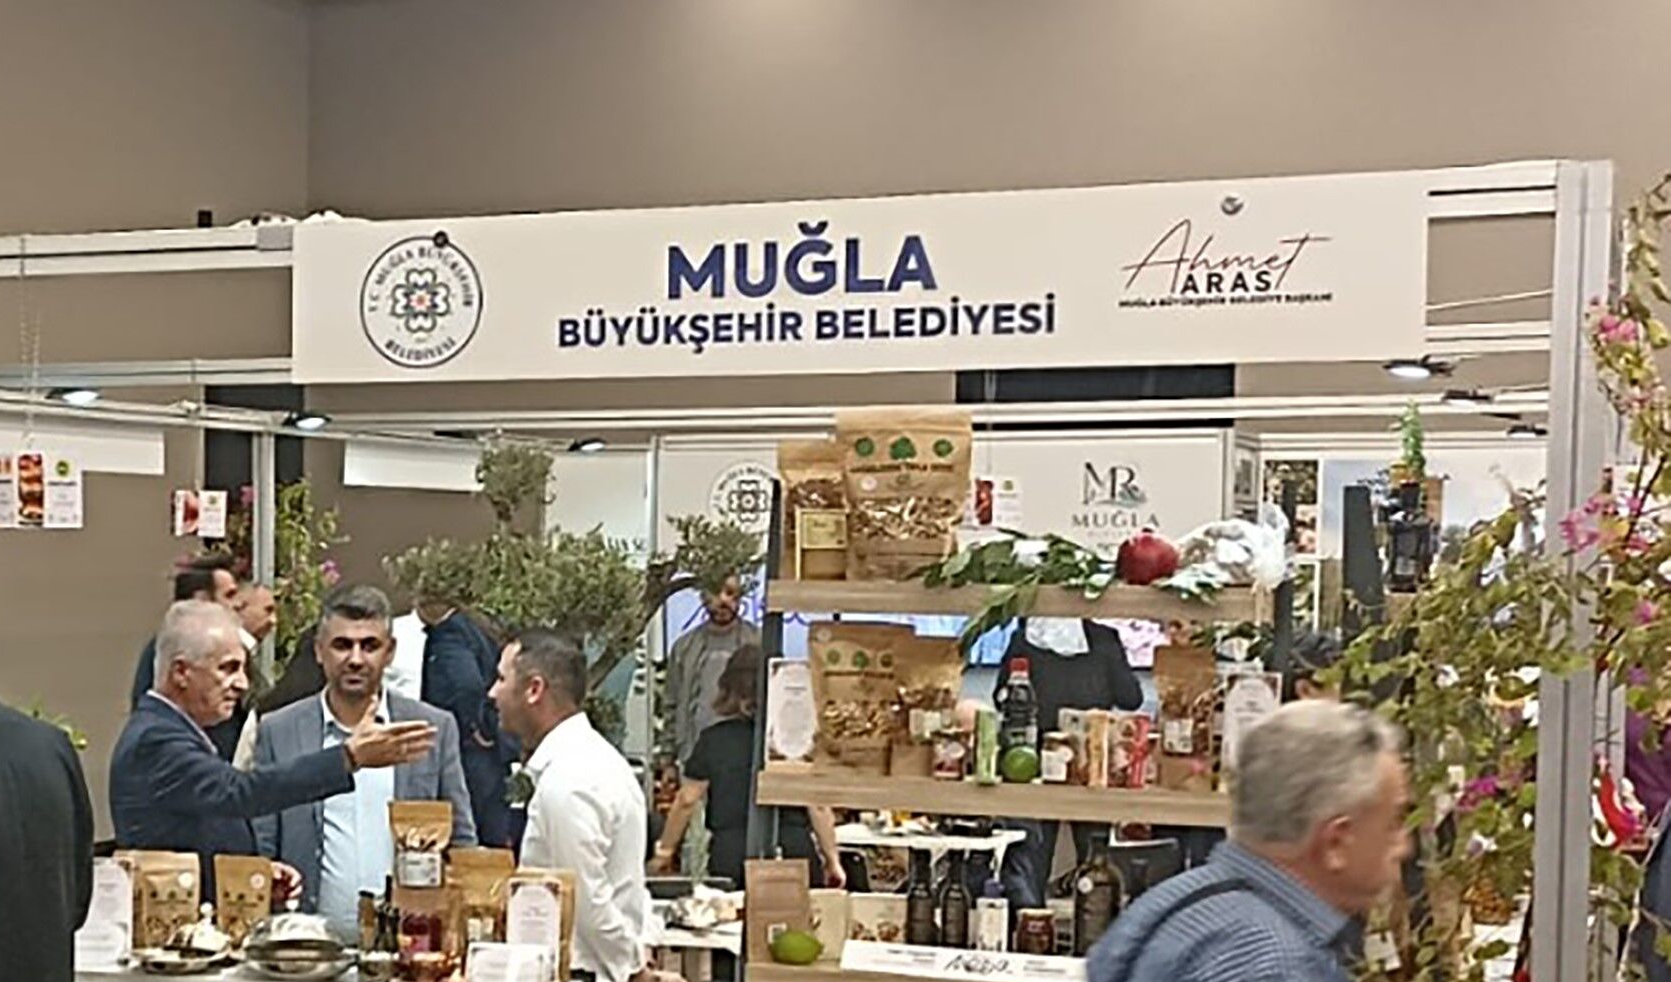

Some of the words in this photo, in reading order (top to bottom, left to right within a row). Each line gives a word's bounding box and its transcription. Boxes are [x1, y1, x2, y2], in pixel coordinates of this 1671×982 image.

[667, 221, 937, 300] MUĞLA
[1121, 219, 1333, 295] Ahmet
[1180, 270, 1273, 295] ARAS
[558, 303, 803, 355] BÜYÜKŞEHİR
[814, 293, 1056, 341] BELEDİYESİ
